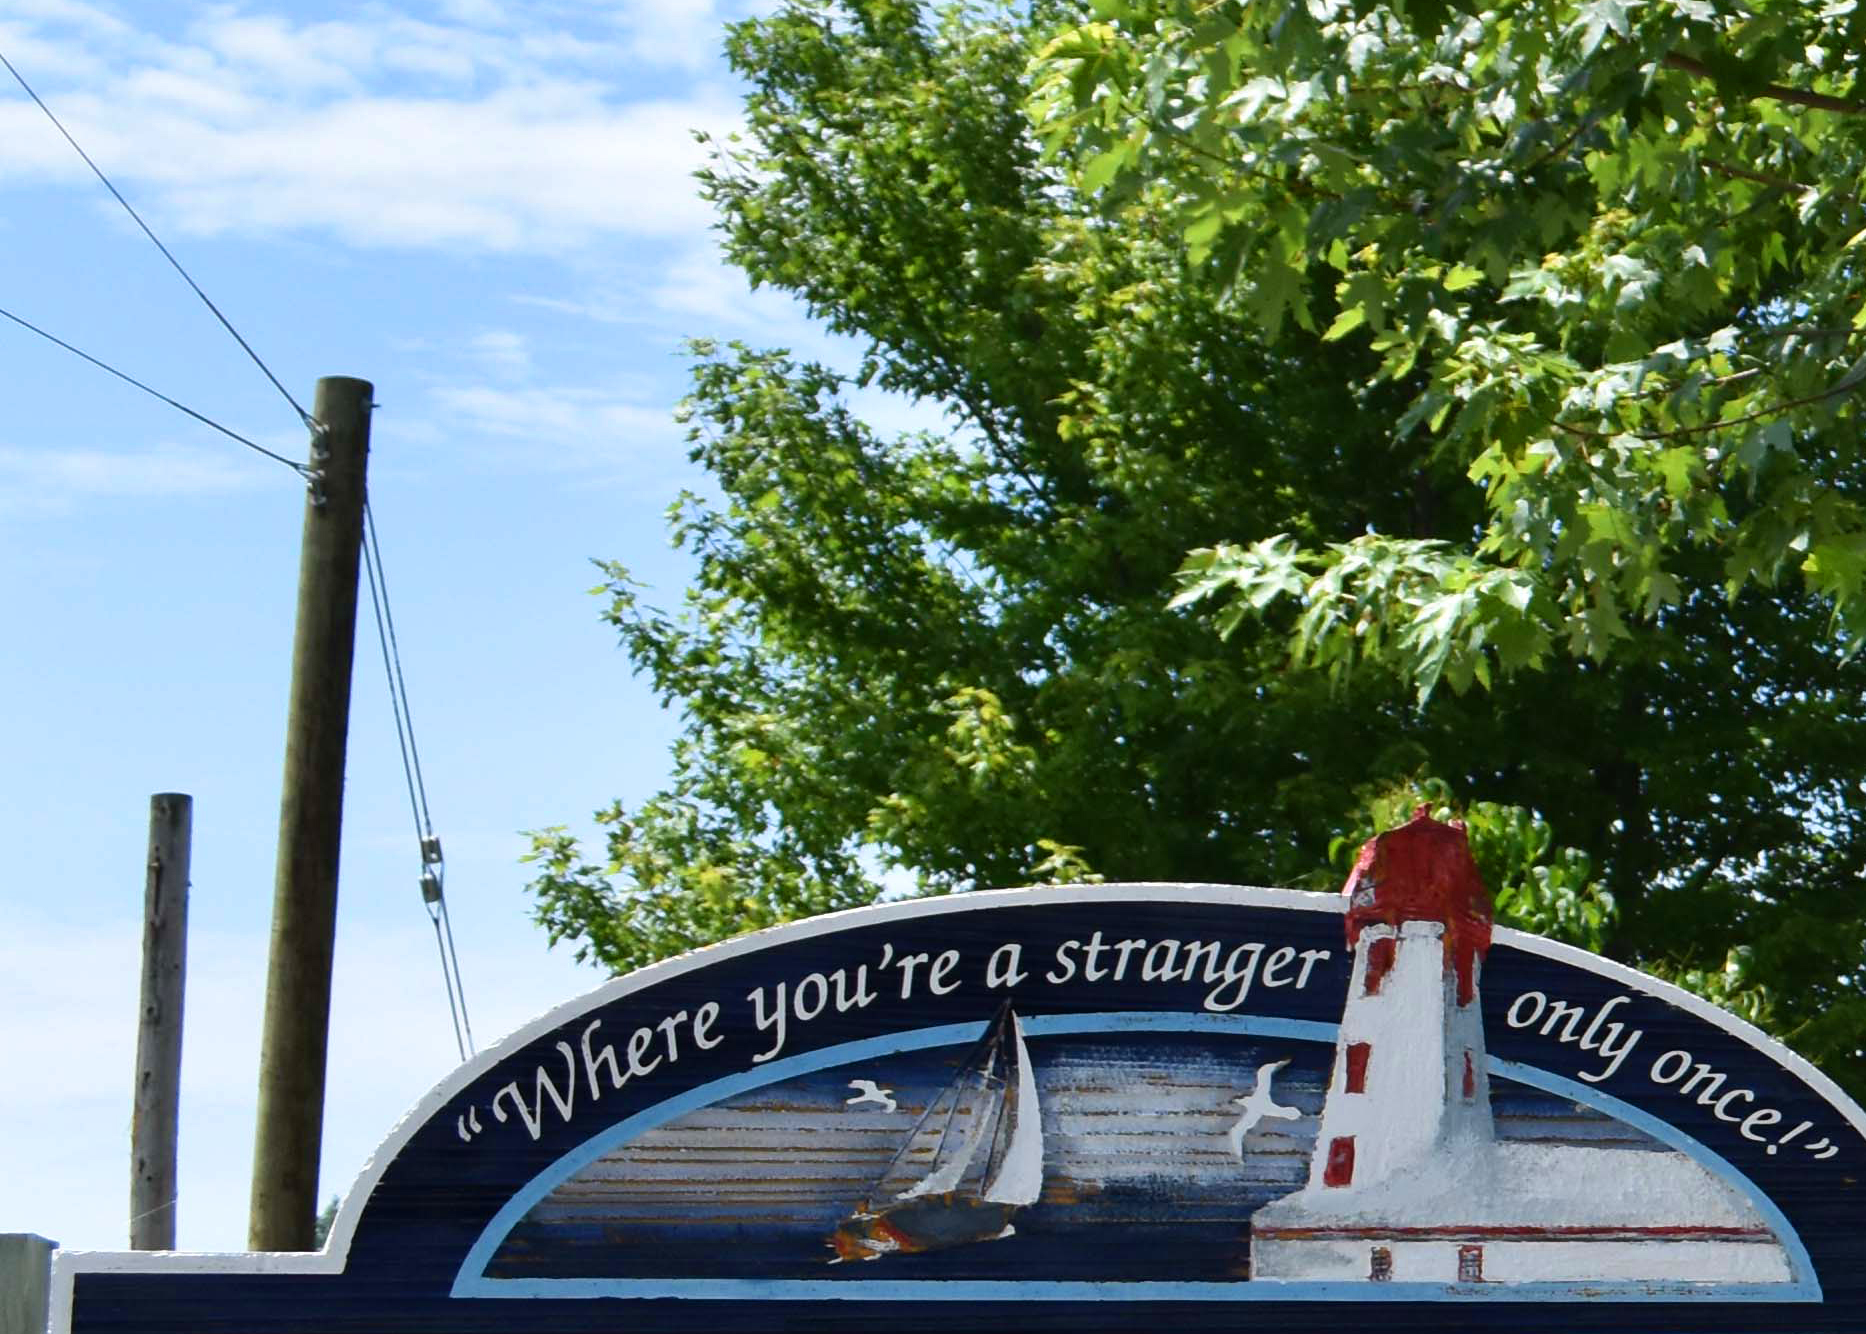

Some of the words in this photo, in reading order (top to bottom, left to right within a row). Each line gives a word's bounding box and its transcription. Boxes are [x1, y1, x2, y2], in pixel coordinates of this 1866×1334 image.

[986, 943, 1028, 988] a
[1046, 931, 1331, 1012] stranger
[1507, 991, 1642, 1082] only
